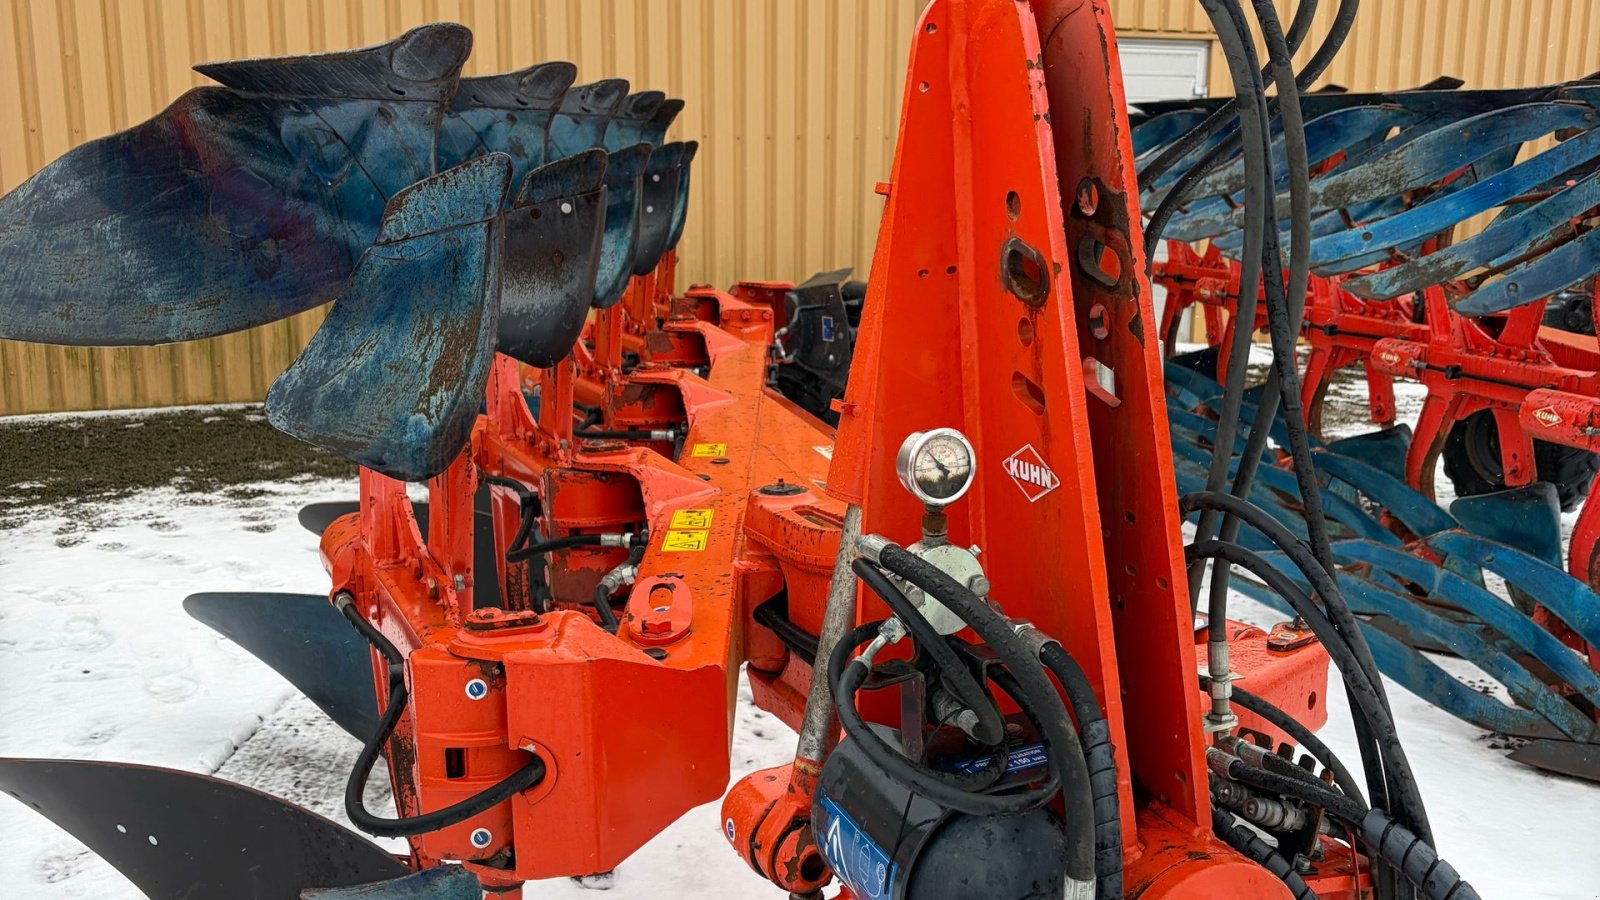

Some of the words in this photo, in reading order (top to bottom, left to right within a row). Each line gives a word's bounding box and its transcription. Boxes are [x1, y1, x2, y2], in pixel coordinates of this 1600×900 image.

[1536, 410, 1558, 423] KUHN
[1009, 457, 1052, 489] KUHN
[1013, 757, 1031, 766] 150
